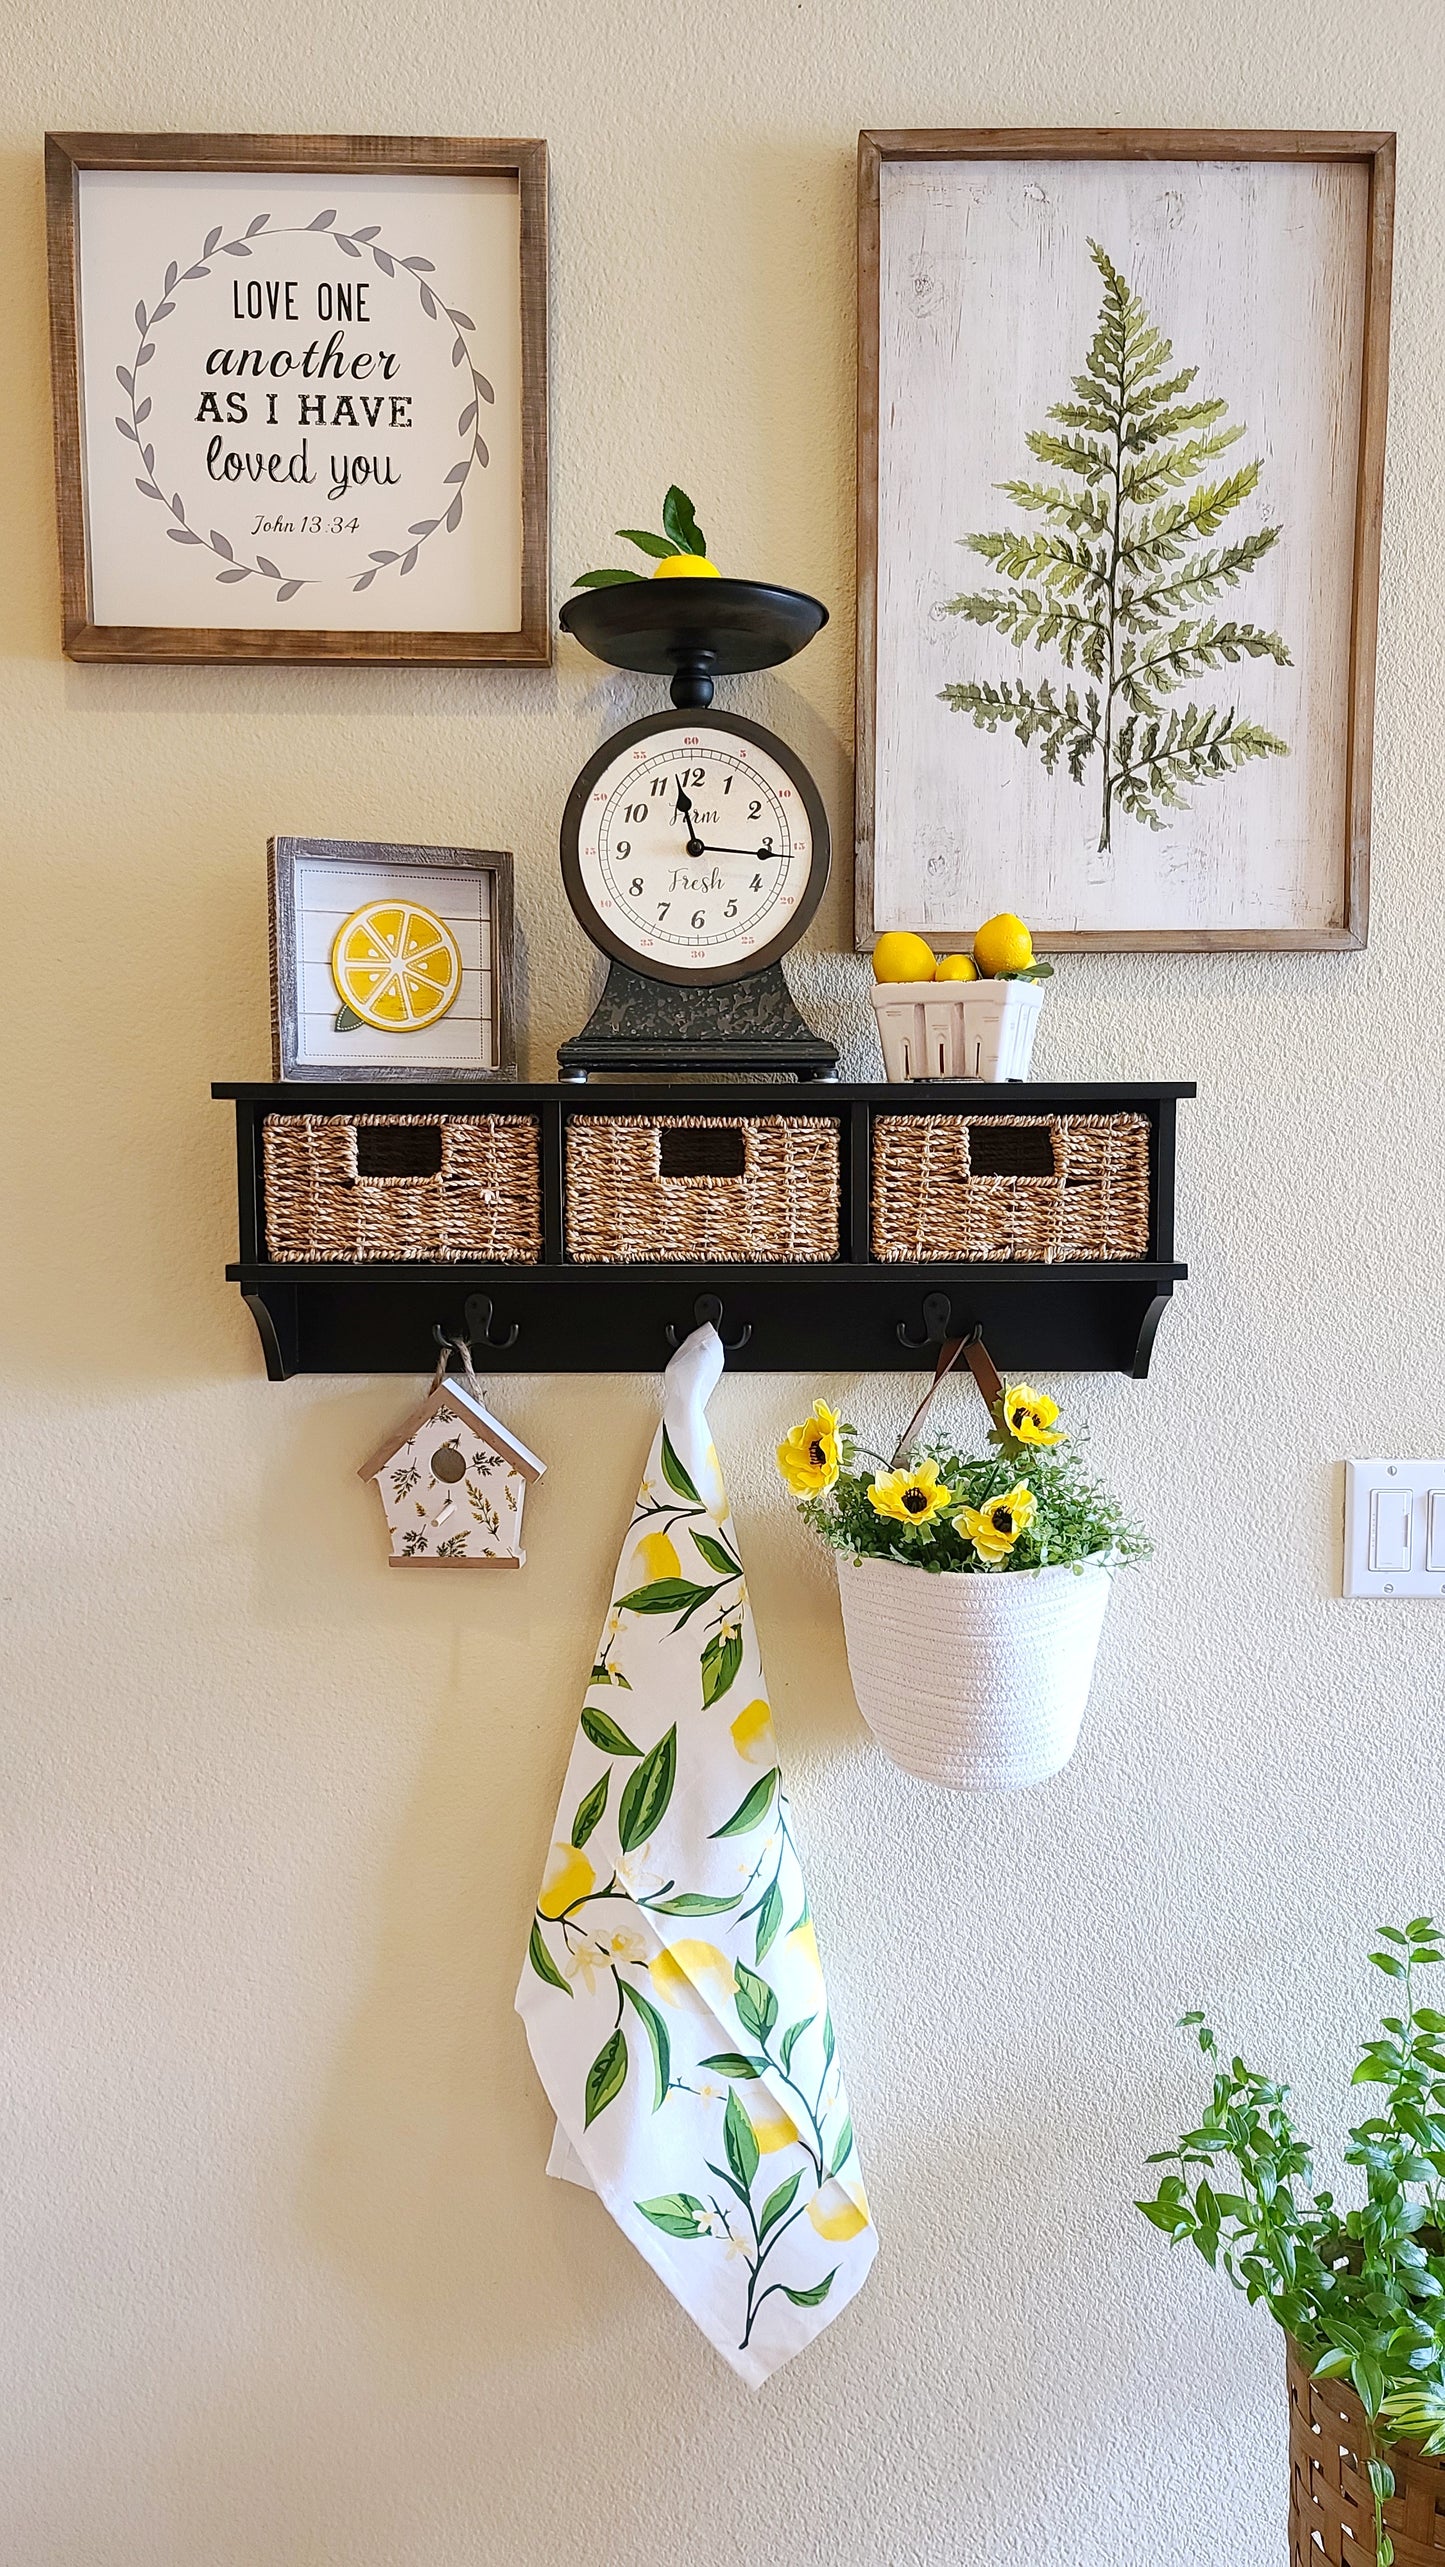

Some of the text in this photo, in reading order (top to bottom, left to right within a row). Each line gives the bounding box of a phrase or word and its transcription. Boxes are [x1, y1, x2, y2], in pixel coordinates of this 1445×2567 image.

[233, 279, 371, 322] LOVE ONE
[205, 329, 401, 380] another
[194, 391, 413, 428] AS I HAVE
[206, 434, 402, 501] loved you
[250, 514, 360, 536] John 13:34
[683, 736, 699, 745] 60
[739, 749, 747, 758] 5
[650, 777, 668, 797] 11
[681, 767, 706, 788] 12
[723, 775, 734, 795] 1
[777, 789, 792, 799] 10
[624, 803, 649, 824] 10
[747, 800, 762, 820] 2
[615, 840, 631, 861] 9
[628, 877, 644, 897] 8
[668, 866, 725, 893] Fresh
[748, 873, 763, 893] 4
[656, 902, 671, 922] 7
[723, 898, 738, 918] 5
[690, 909, 706, 929] 6
